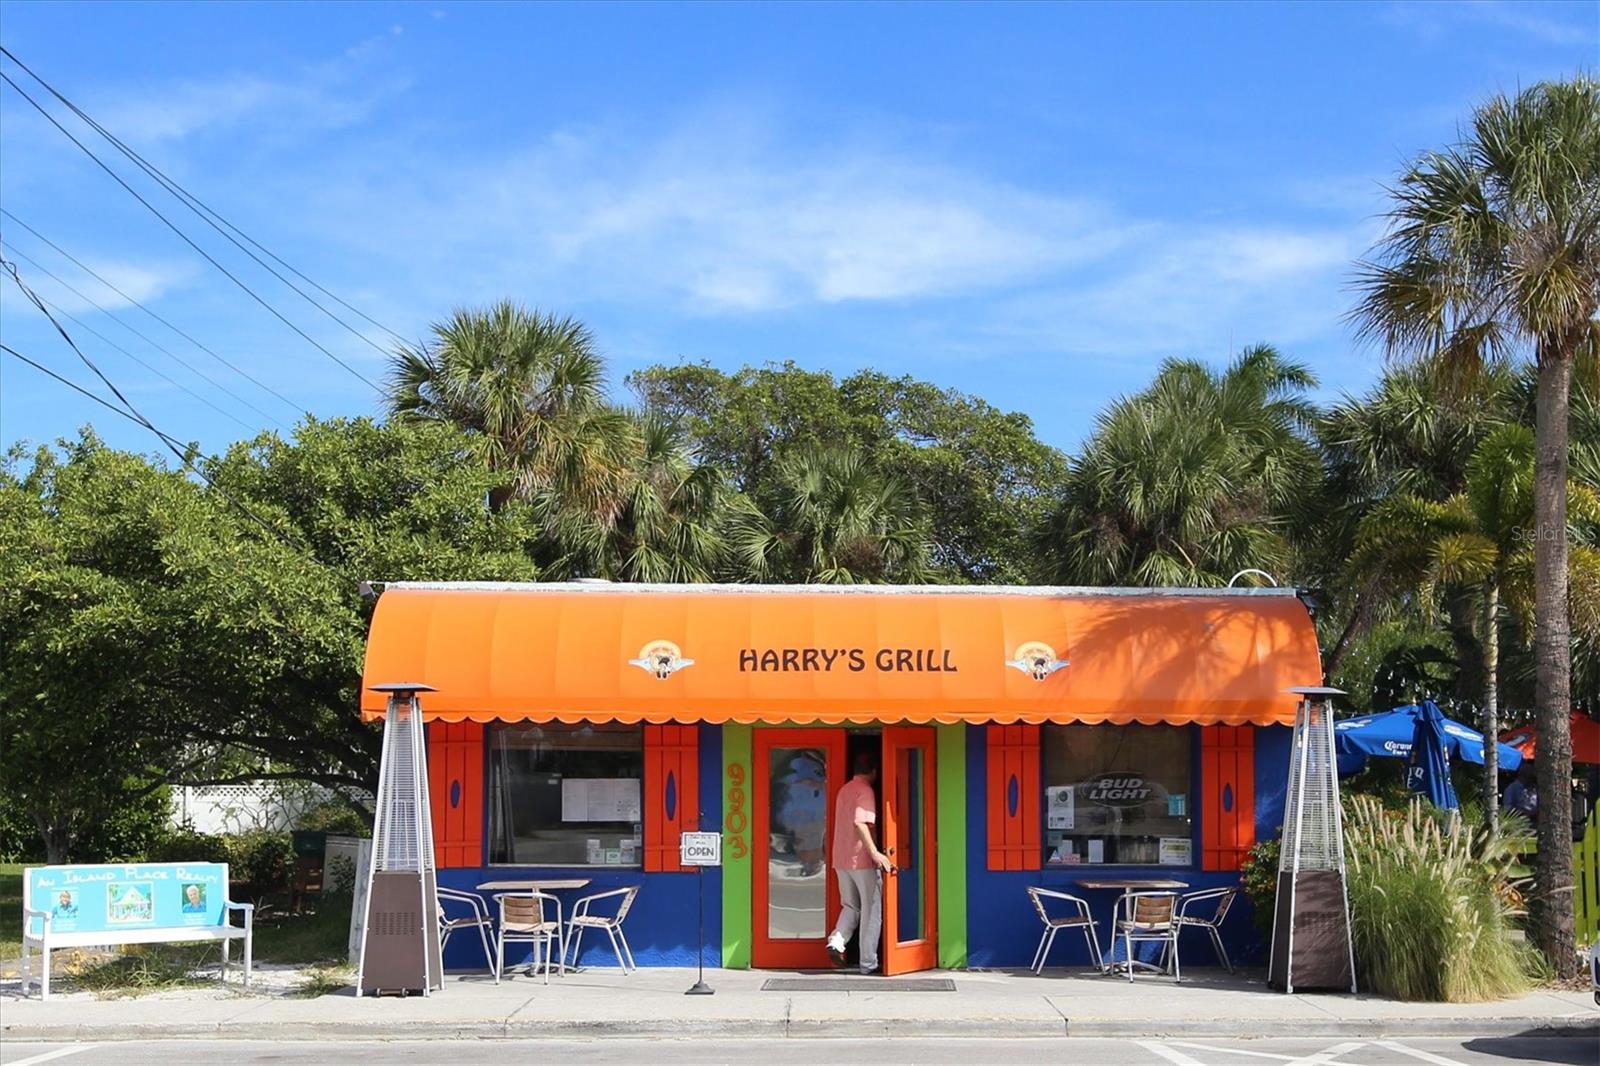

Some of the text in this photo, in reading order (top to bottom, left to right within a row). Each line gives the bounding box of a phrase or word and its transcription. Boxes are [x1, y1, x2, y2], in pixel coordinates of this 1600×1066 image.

[739, 648, 958, 673] HARRY'S GRILL
[1098, 779, 1143, 789] BUD
[1089, 789, 1151, 799] LIGHT
[726, 763, 747, 858] 9903
[687, 846, 714, 857] OPEN
